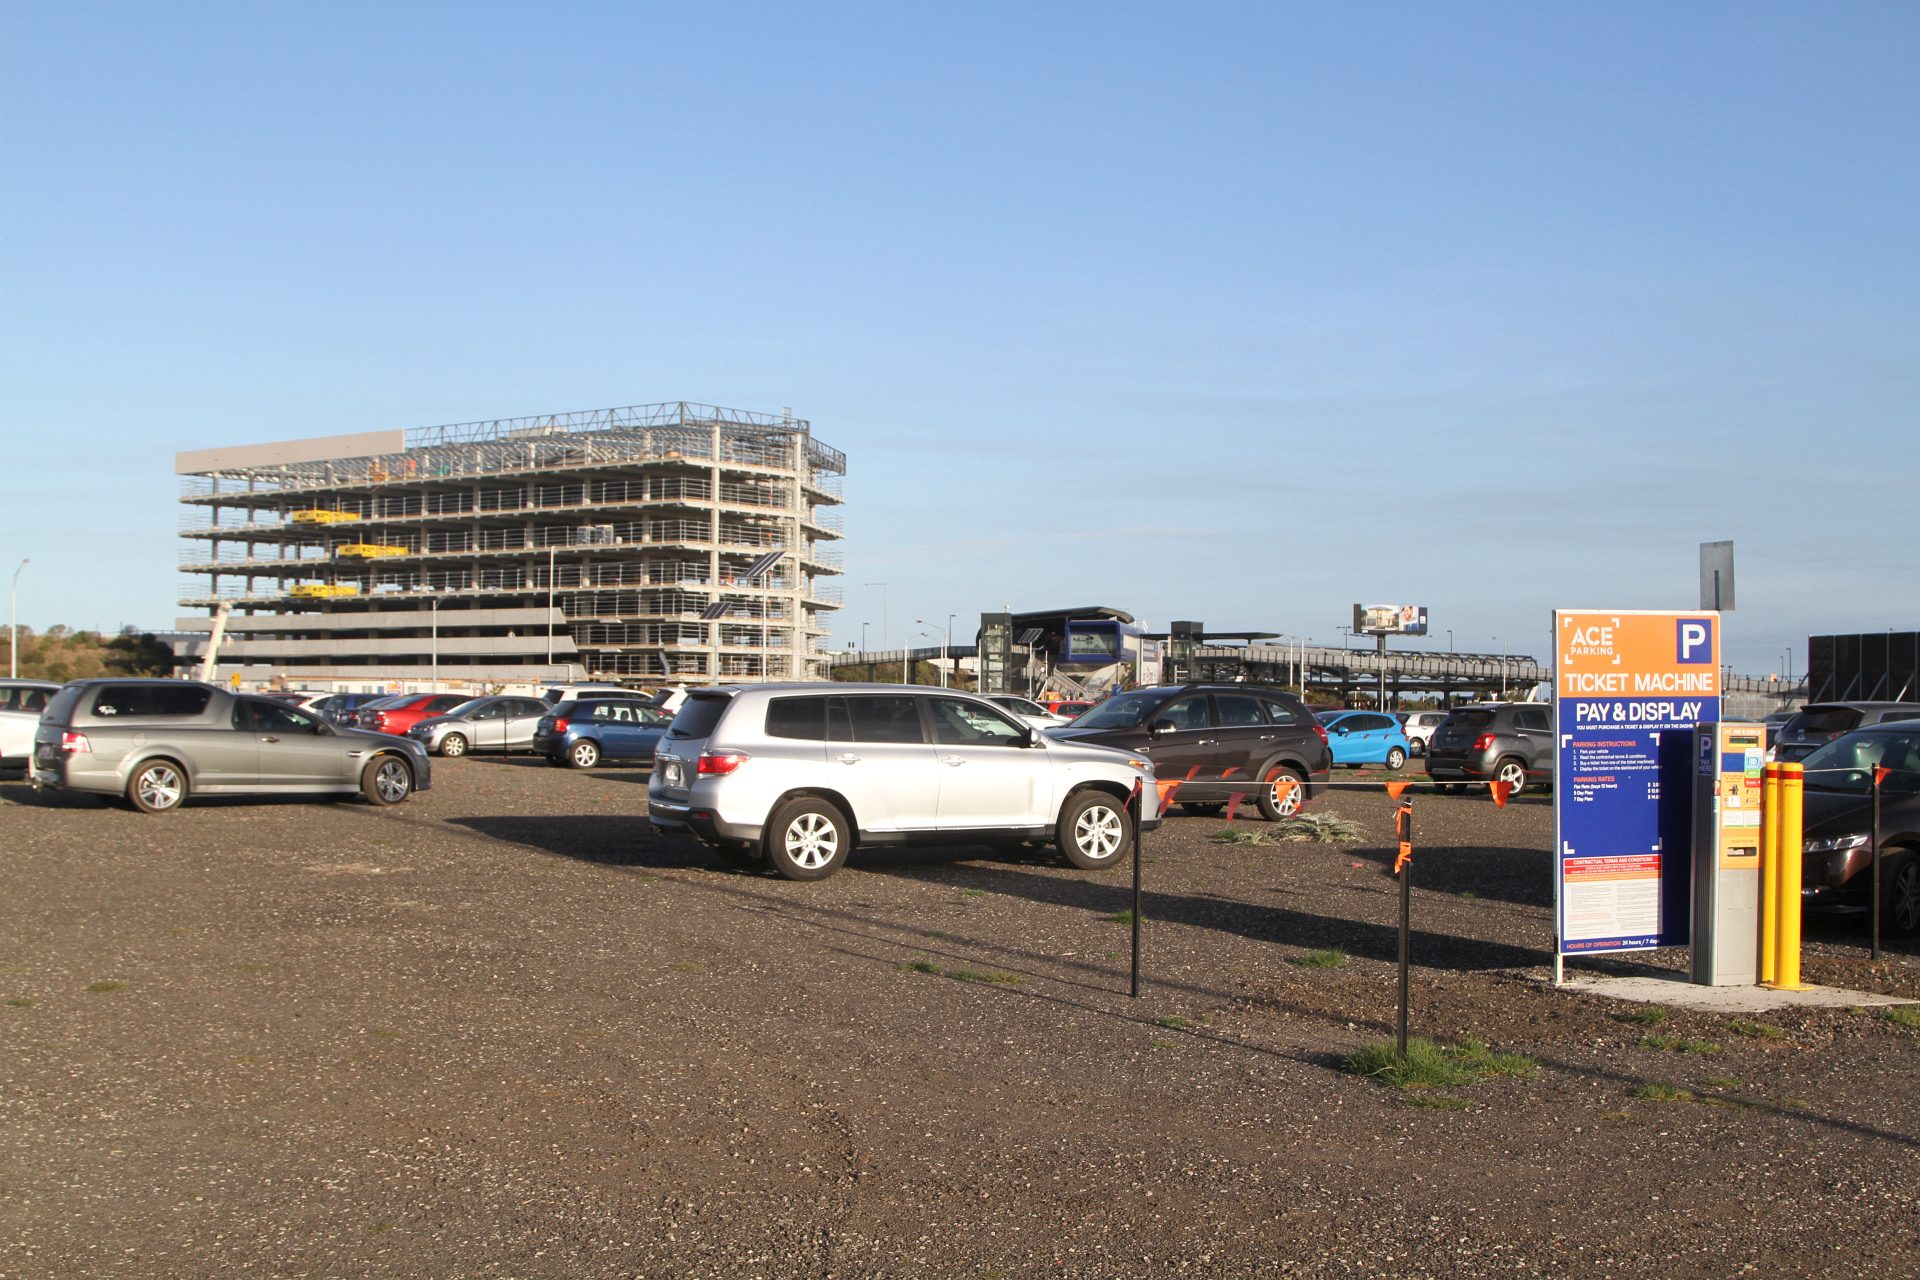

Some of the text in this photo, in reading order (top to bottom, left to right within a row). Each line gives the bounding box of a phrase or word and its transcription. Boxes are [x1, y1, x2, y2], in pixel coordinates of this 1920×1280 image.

[1570, 626, 1613, 646] ACE
[1682, 624, 1706, 659] P
[1570, 647, 1613, 655] PARKING
[1565, 673, 1712, 692] TICKET MACHINE
[1576, 702, 1701, 722] PAY & DISPLAY
[1700, 736, 1712, 757] P
